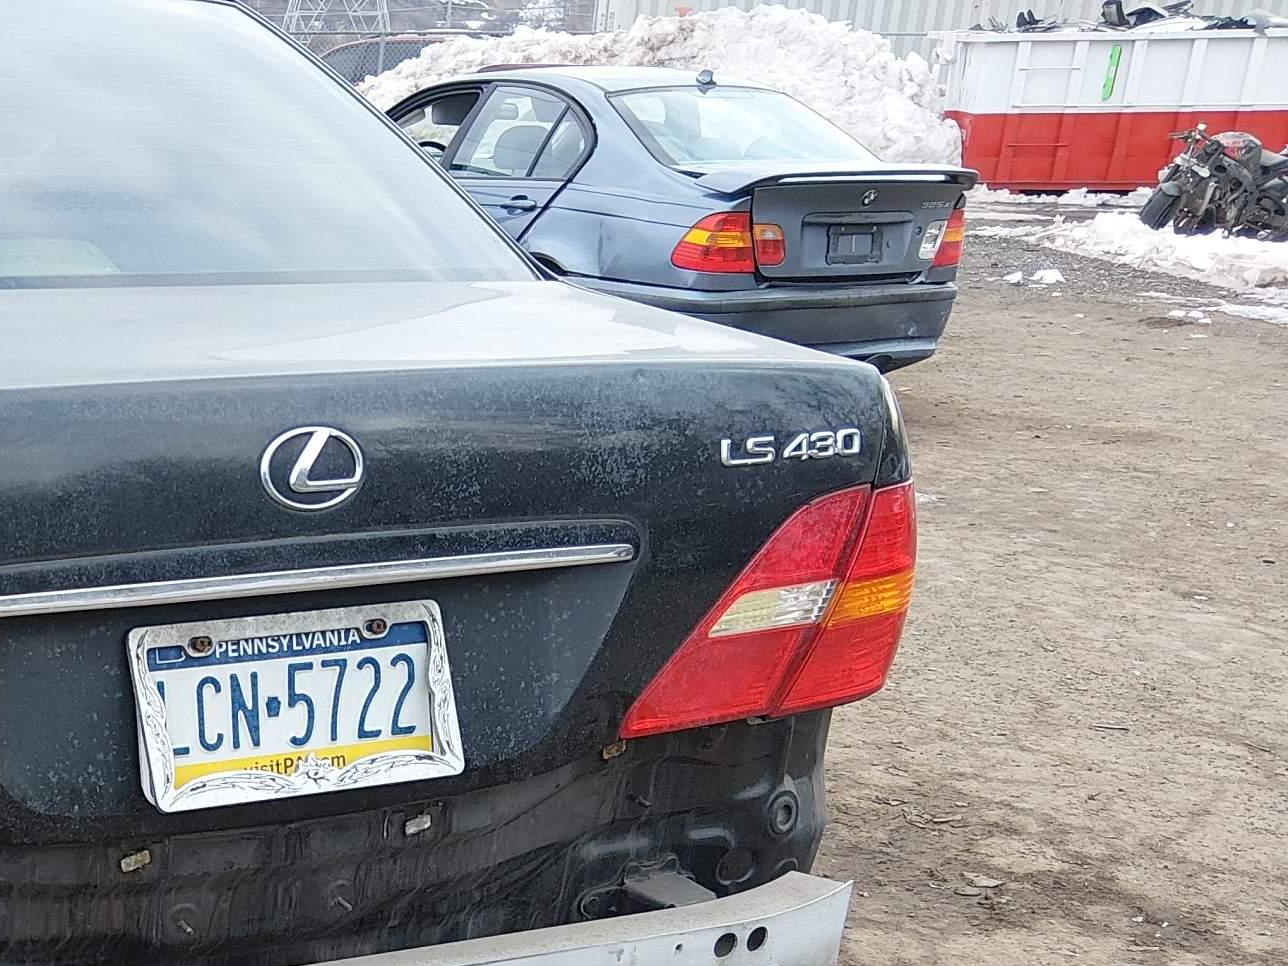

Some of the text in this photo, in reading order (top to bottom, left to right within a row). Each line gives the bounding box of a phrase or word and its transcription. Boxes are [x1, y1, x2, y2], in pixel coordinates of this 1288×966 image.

[720, 428, 861, 466] LS 430
[214, 629, 361, 659] PENNSYLVANIA
